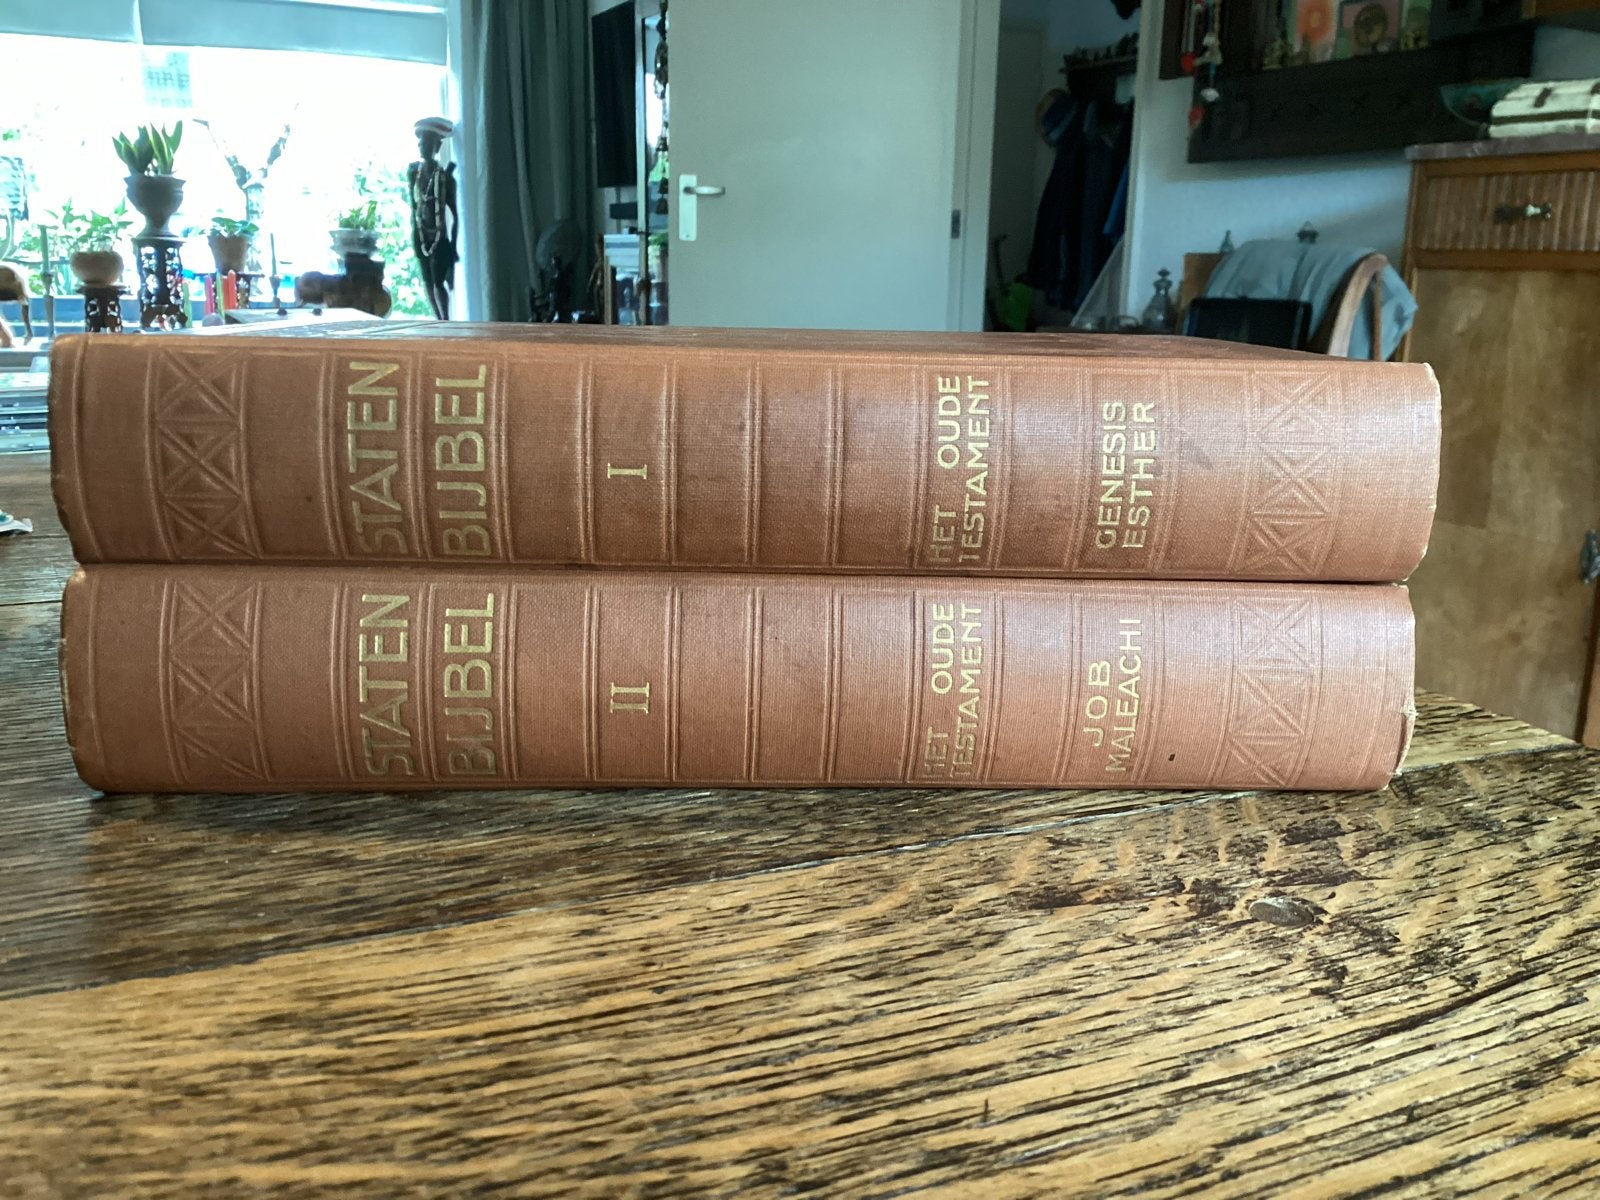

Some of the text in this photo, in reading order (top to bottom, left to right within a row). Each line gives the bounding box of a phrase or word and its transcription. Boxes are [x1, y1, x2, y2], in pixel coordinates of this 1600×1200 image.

[347, 361, 408, 556] STATEN
[434, 364, 491, 555] BIJBEL
[606, 462, 648, 480] I
[930, 376, 961, 563] HET OUDE
[958, 375, 990, 563] TESTAMENT
[1094, 400, 1127, 549] GENESIS
[1122, 401, 1155, 548] ESTHER
[359, 593, 414, 776] STATEN
[443, 592, 497, 775] BIJBEL
[609, 681, 650, 714] II
[931, 603, 954, 694] OUDE
[950, 599, 983, 777] TESTAMENT
[1083, 660, 1110, 747] JOB
[1105, 618, 1142, 772] MALEACHI
